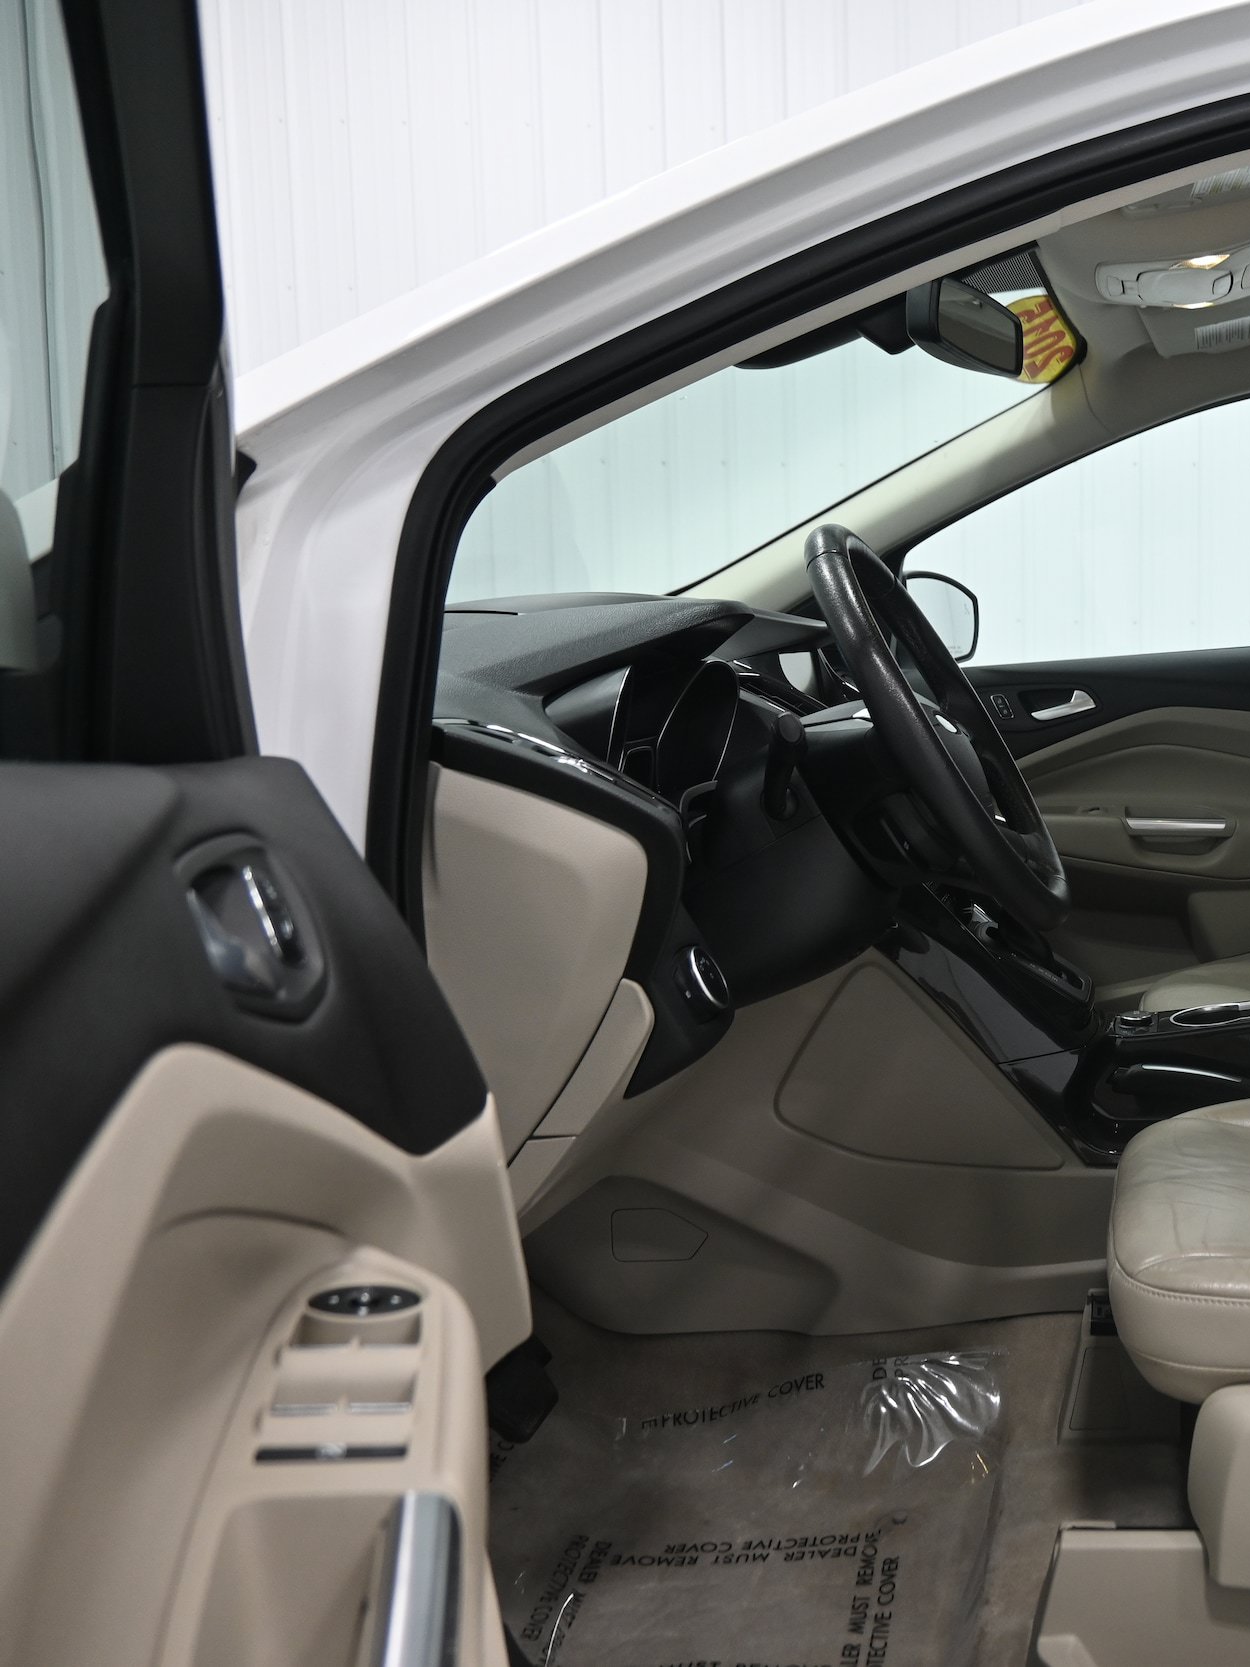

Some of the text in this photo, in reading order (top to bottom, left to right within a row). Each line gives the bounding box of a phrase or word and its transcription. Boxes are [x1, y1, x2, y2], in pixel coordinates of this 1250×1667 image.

[768, 1373, 825, 1398] COVER
[665, 1531, 861, 1553] PROTECTIVE COVER
[610, 1545, 857, 1567] DEALER MUST REMOVE
[877, 1556, 900, 1606] COVER
[848, 1595, 871, 1634] MUST
